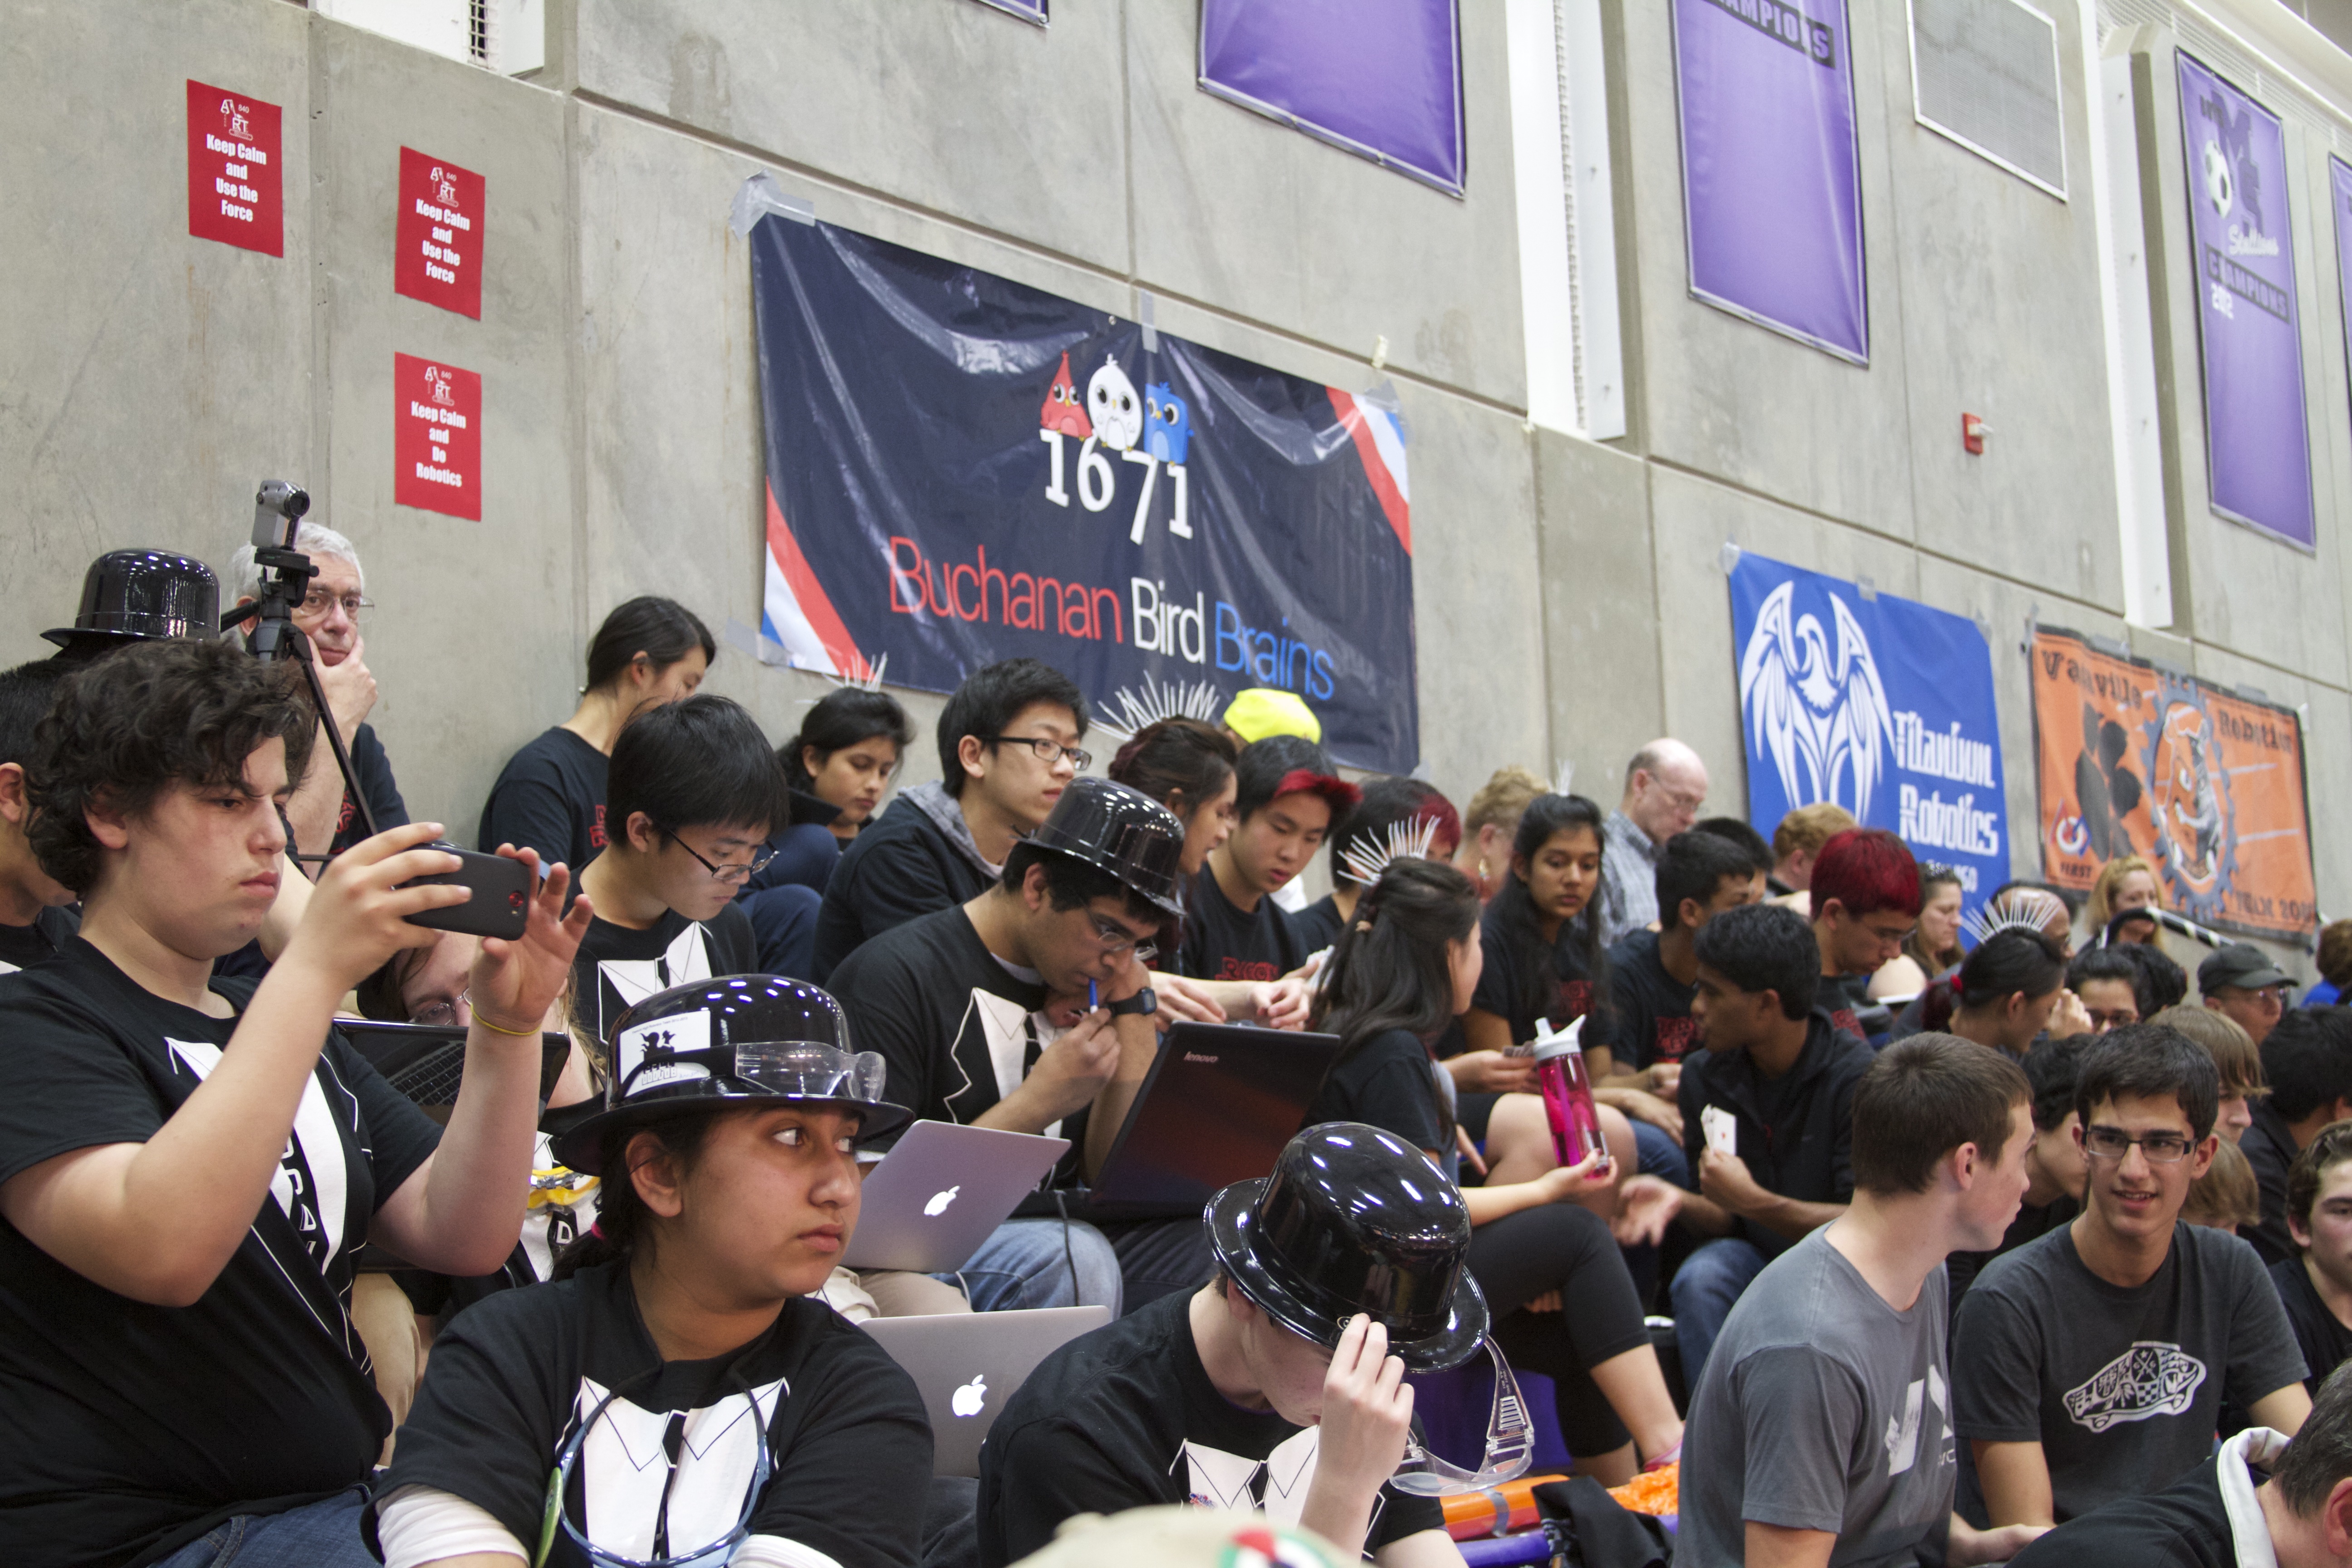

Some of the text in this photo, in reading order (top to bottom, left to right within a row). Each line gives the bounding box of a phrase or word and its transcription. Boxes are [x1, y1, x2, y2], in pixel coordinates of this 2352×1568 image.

[206, 133, 267, 165] Keep Calm
[225, 162, 248, 180] and
[216, 177, 258, 203] Use the
[221, 199, 253, 222] Force
[416, 198, 470, 231] Keep Calm
[432, 226, 452, 244] and
[422, 240, 461, 267] Use the
[426, 261, 455, 284] Force
[411, 400, 467, 429] Keep Calm
[429, 427, 450, 444] and
[432, 445, 446, 463] Do
[416, 461, 462, 488] Robotics
[1039, 428, 1193, 545] 1671
[888, 535, 1335, 701] Buchanan Bird Brains
[1893, 710, 1995, 789] Titanium
[1899, 783, 1999, 857] Robotics
[1183, 1051, 1219, 1063] lenovo
